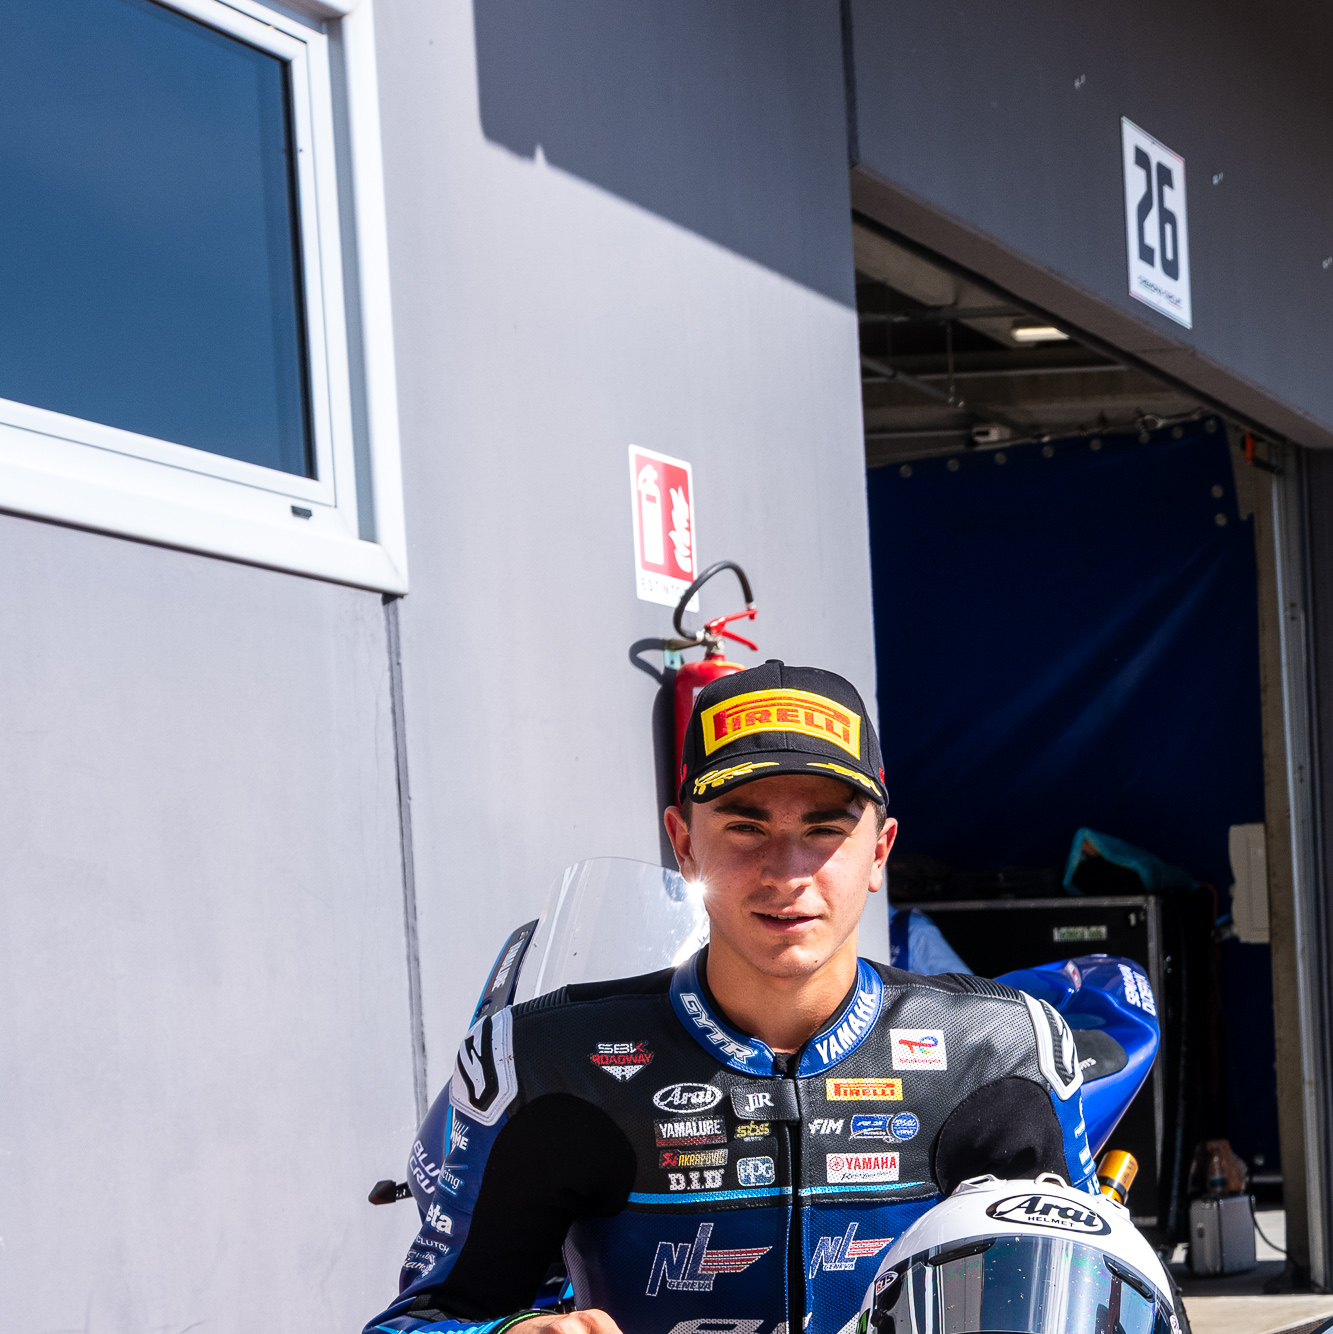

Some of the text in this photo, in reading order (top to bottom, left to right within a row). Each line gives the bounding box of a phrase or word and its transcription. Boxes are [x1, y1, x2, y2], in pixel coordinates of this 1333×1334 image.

[1134, 144, 1179, 282] 26
[712, 696, 851, 745] PIRELLI
[680, 993, 757, 1063] GYTR
[816, 991, 876, 1064] YAMAHA
[591, 1052, 653, 1065] ROADWAY
[659, 1087, 715, 1105] Arai
[834, 1083, 895, 1097] PIRELLI
[659, 1120, 721, 1138] YAMALUBE
[811, 1119, 845, 1135] FIM
[414, 1139, 441, 1177] BLU
[846, 1157, 896, 1170] YAMAHA
[409, 1155, 436, 1194] CRU
[668, 1170, 723, 1190] D.I.D
[426, 1203, 453, 1235] eta
[994, 1196, 1099, 1228] Arai
[1027, 1216, 1075, 1227] HELMET
[666, 1279, 713, 1291] GENEVA
